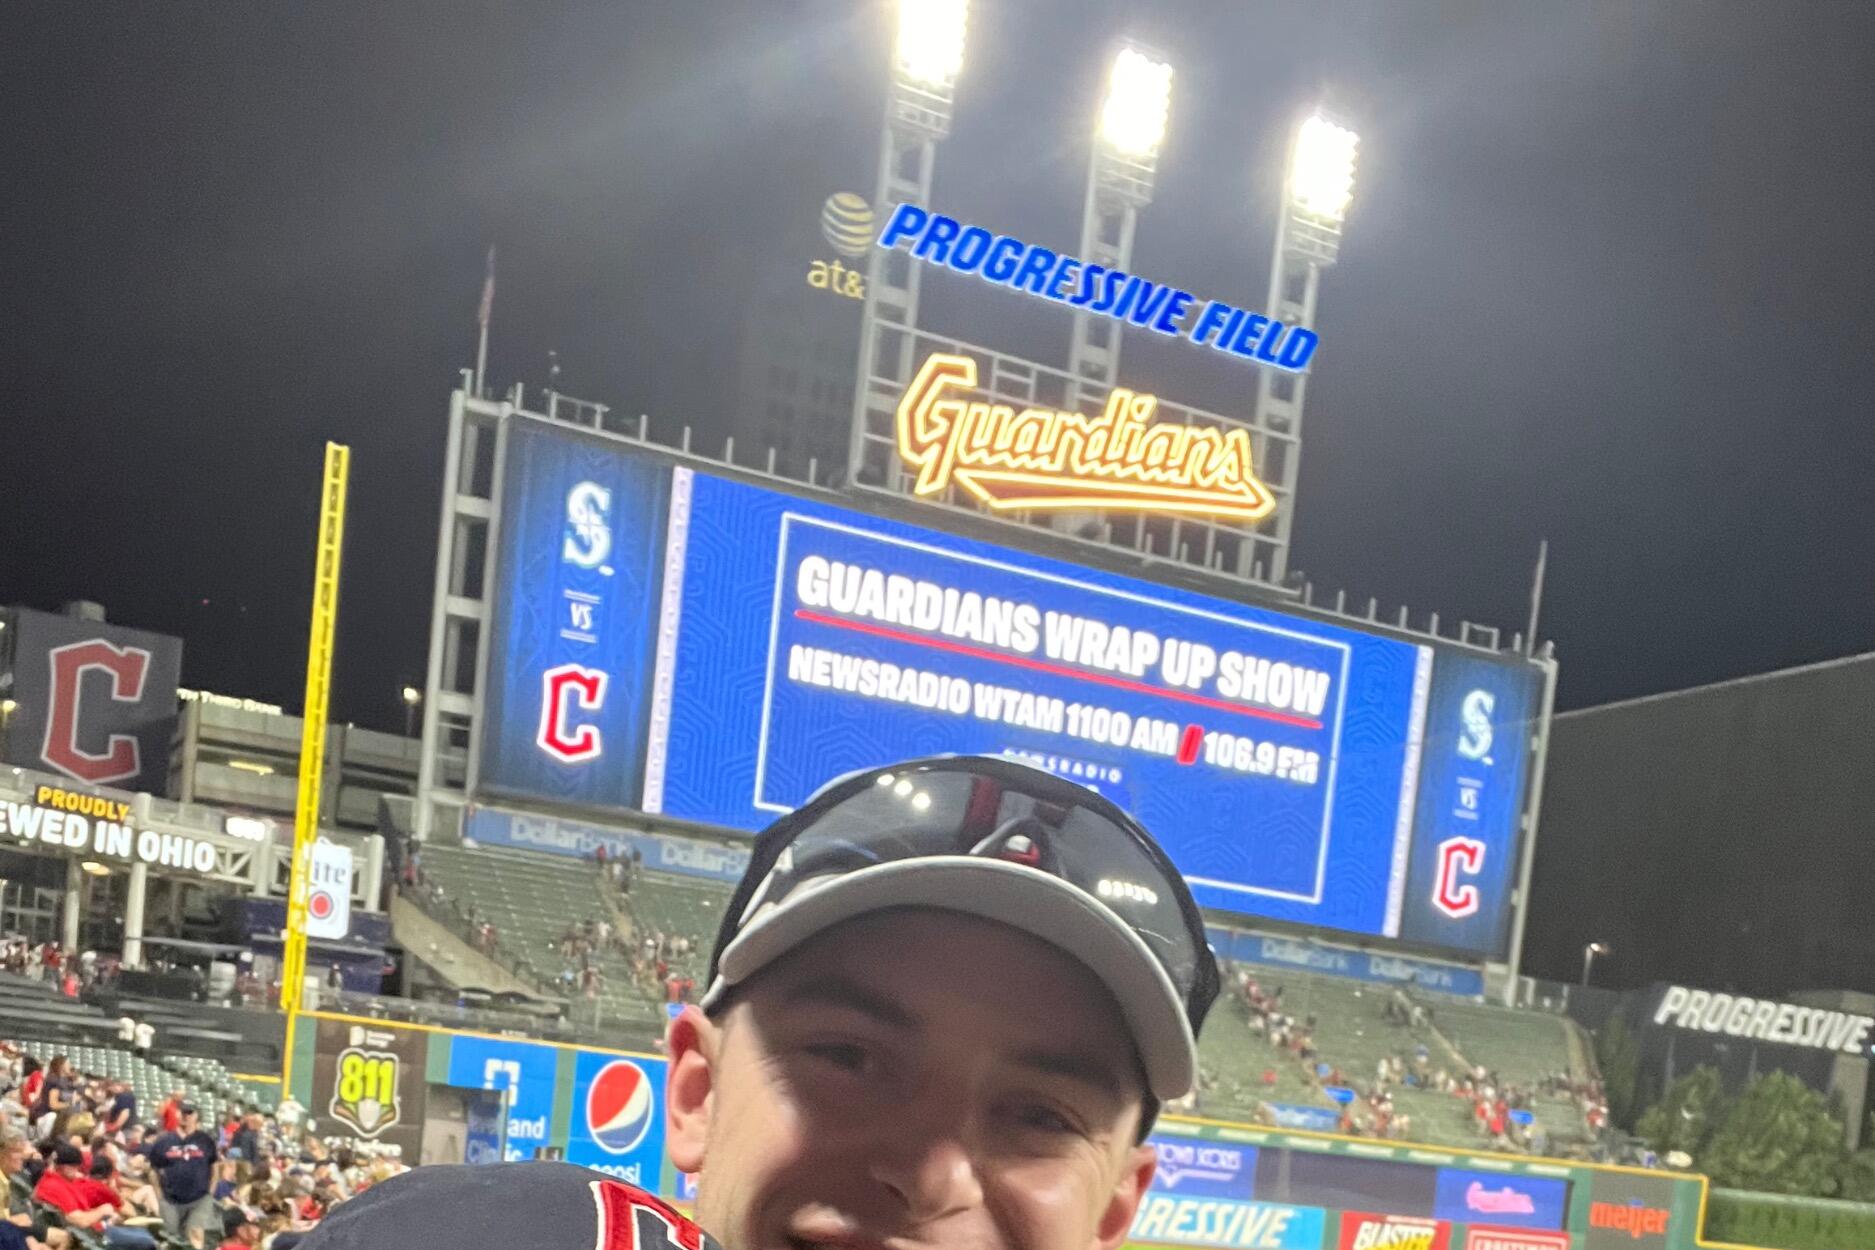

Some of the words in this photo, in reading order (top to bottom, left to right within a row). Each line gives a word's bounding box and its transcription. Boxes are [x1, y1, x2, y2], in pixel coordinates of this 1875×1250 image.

[807, 259, 865, 299] at&
[877, 203, 1194, 337] PROGRESSIVE
[1189, 300, 1319, 373] FIELD
[897, 352, 1275, 517] Guardians
[570, 603, 594, 631] VS
[797, 555, 1041, 653] GUARDIANS
[1045, 610, 1159, 677] WRAP
[1161, 638, 1217, 690] UP
[1217, 651, 1331, 715] SHOW
[41, 638, 150, 785] C
[537, 664, 608, 763] C
[788, 645, 972, 714] NEWSRADIO
[974, 683, 1065, 734] WTAM
[1066, 703, 1132, 747] 1100
[1130, 716, 1179, 756] AM
[1204, 731, 1275, 776] 106.9
[38, 786, 130, 821] PROUDLY
[94, 820, 133, 858] IN
[137, 831, 216, 872] OHIO
[1432, 836, 1486, 918] C
[1654, 986, 1875, 1053] PROGRESSIVE
[340, 1053, 395, 1106] 811
[1589, 1198, 1670, 1238] meijer
